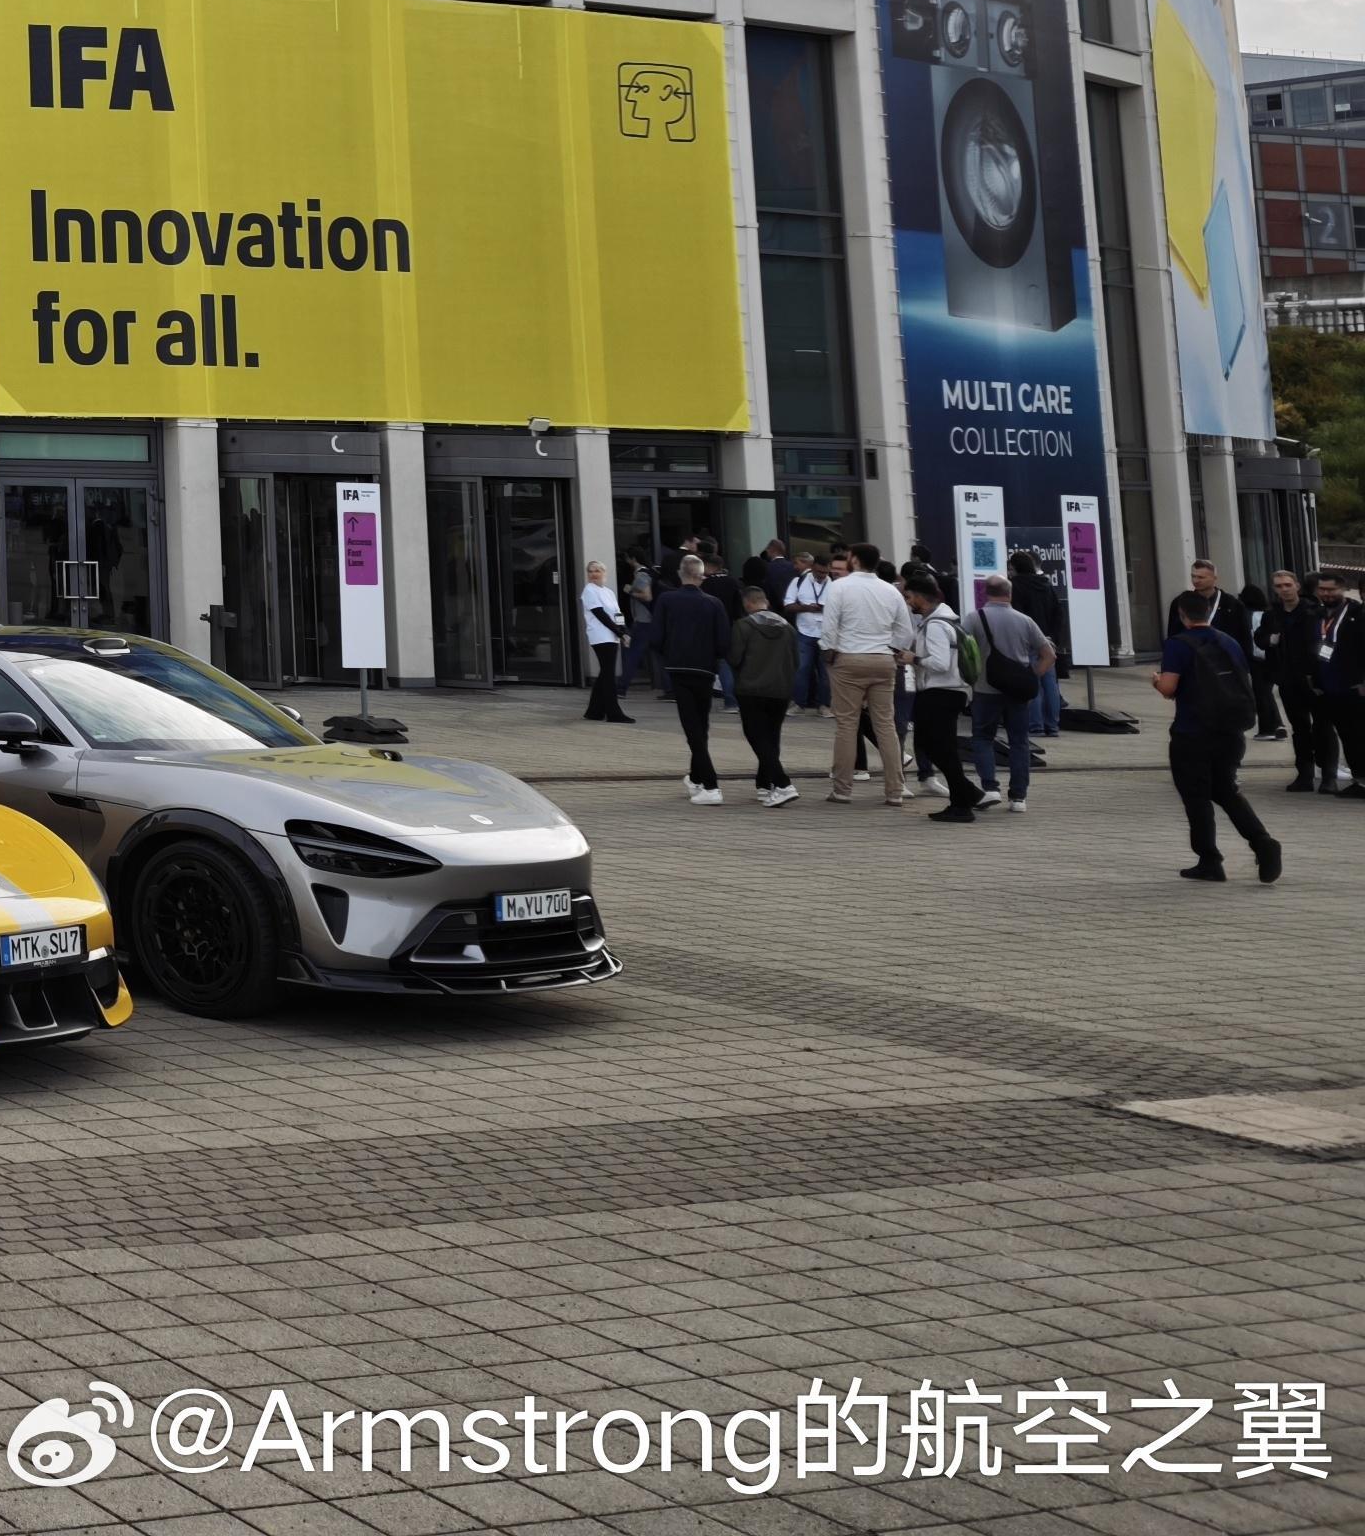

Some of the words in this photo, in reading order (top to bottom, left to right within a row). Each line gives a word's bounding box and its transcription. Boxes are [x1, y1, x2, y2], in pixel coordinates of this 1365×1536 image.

[28, 24, 175, 112] IFA
[30, 189, 411, 273] Innovation
[1320, 205, 1339, 244] 2
[33, 290, 137, 365] for
[155, 293, 260, 368] all.
[942, 379, 1013, 413] MULTI
[1018, 383, 1073, 416] CARE
[950, 426, 1073, 458] COLLECTION
[343, 489, 359, 501] IFA
[964, 492, 979, 502] IFA
[1067, 502, 1080, 512] IFA
[507, 897, 517, 918] M
[525, 896, 542, 916] YU
[546, 893, 568, 914] 700
[11, 935, 41, 961] MTK
